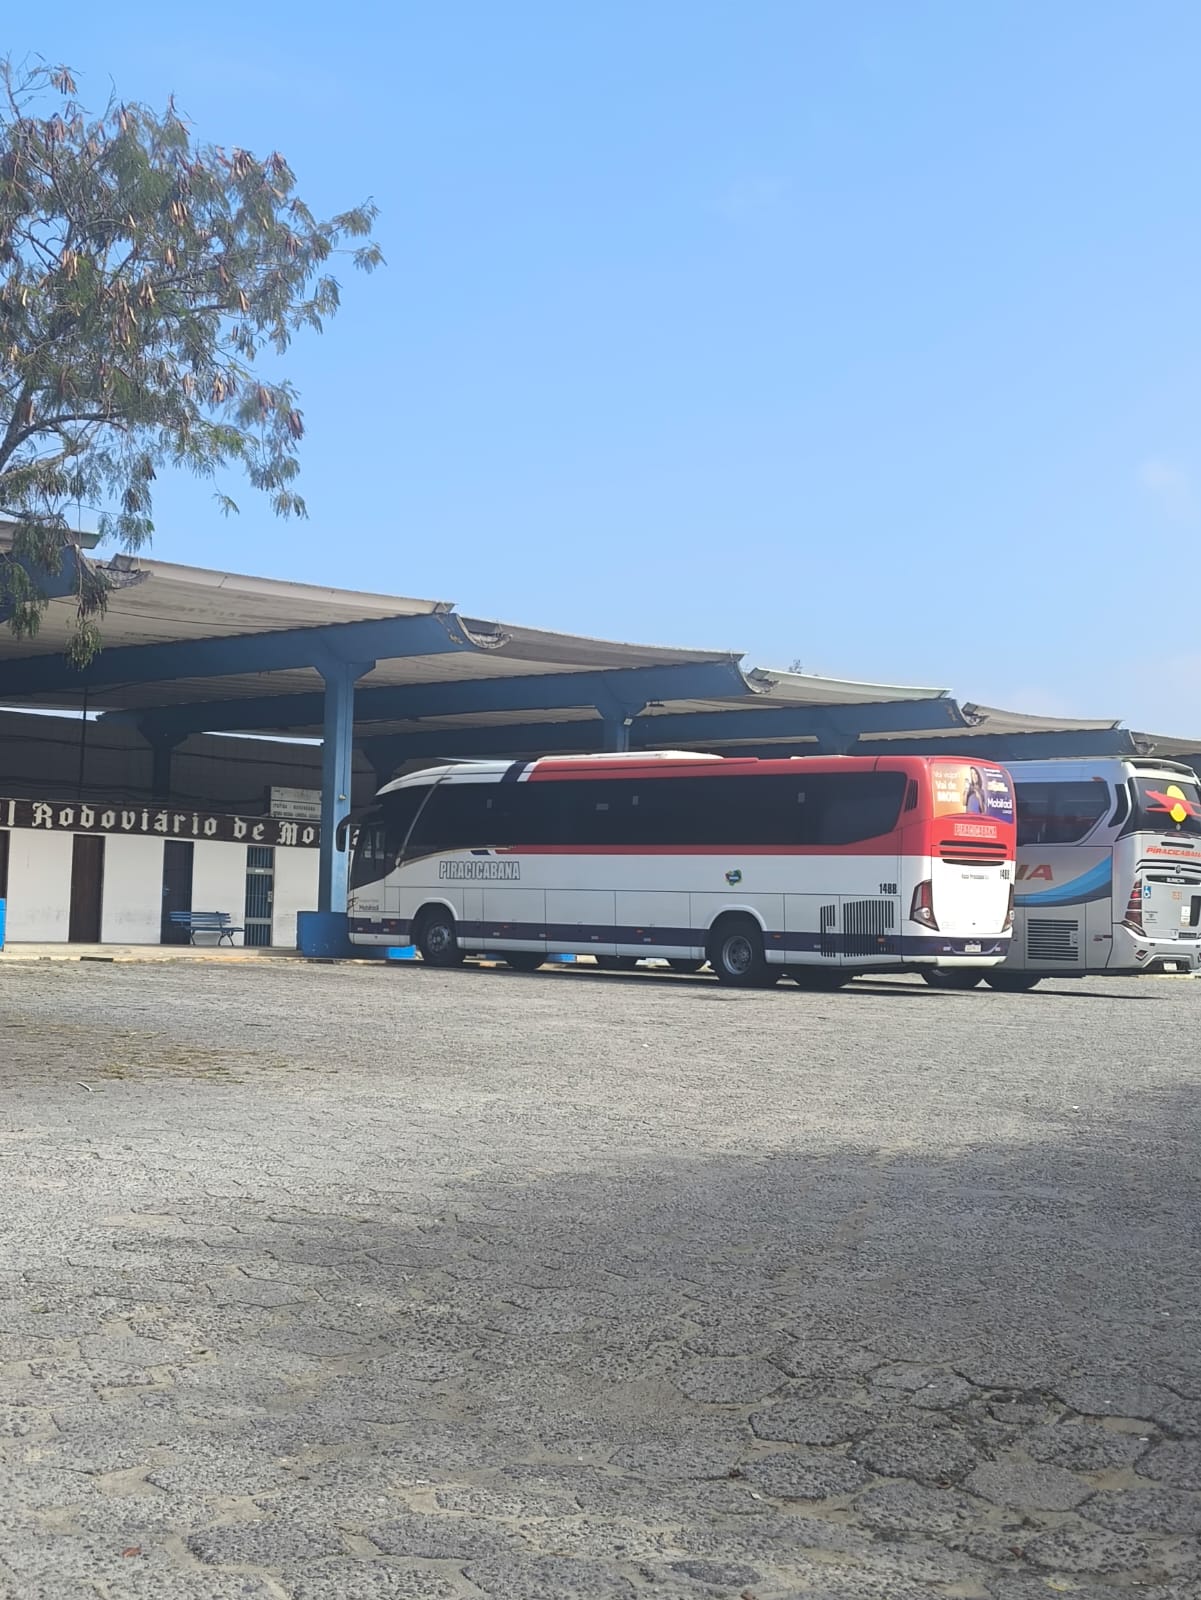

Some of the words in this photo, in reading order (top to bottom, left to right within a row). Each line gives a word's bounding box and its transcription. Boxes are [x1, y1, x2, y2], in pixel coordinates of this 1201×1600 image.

[32, 802, 217, 836] Rodoviário
[233, 816, 264, 841] de
[439, 861, 521, 880] PIRACICABANA
[879, 883, 897, 894] 1488
